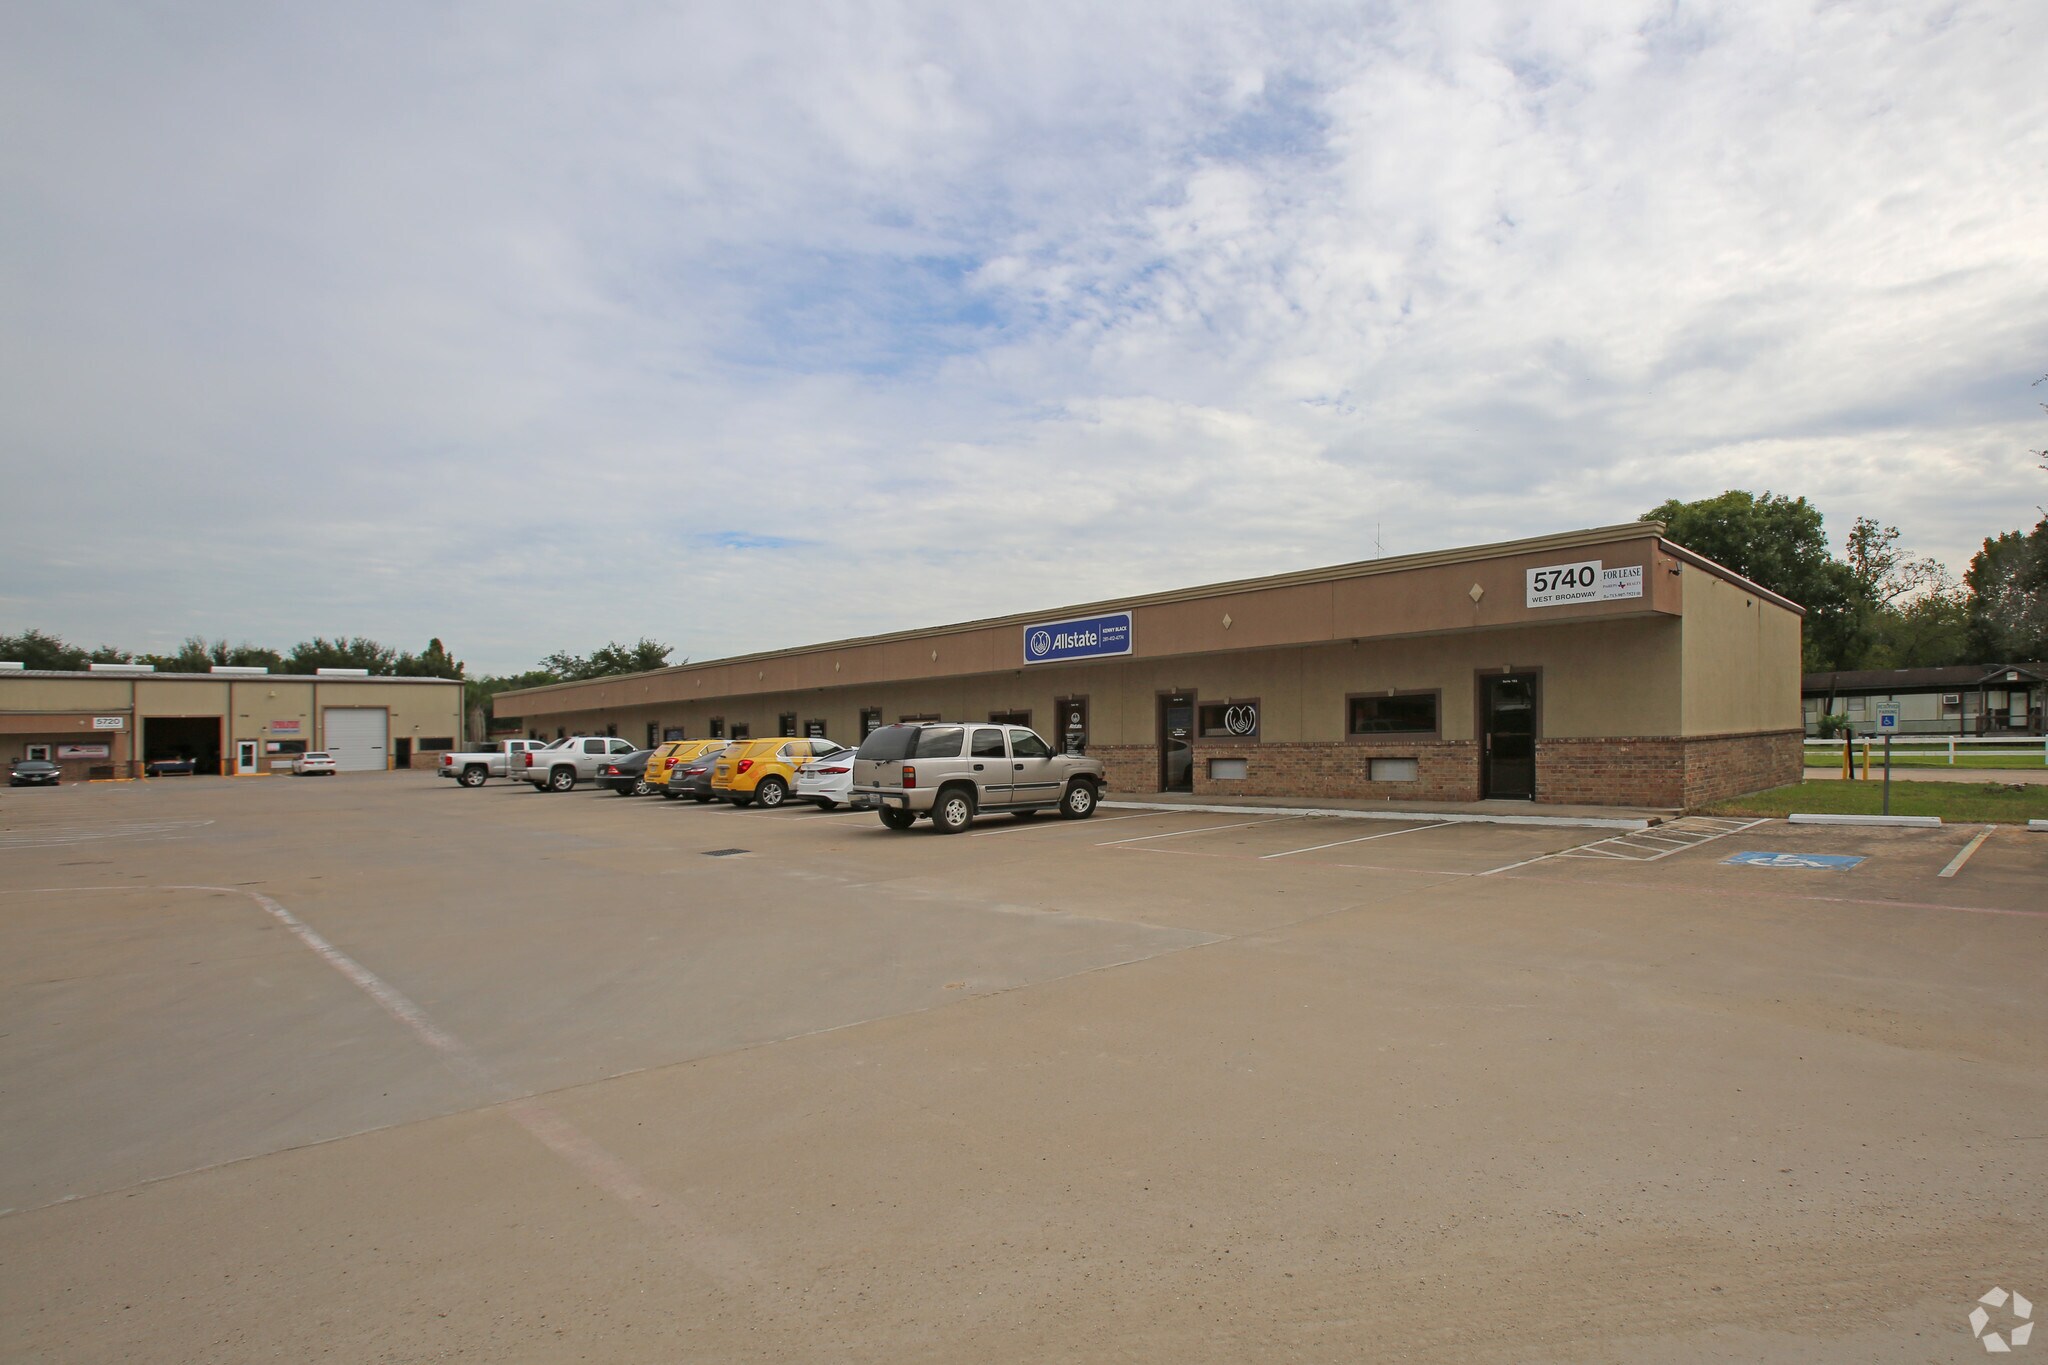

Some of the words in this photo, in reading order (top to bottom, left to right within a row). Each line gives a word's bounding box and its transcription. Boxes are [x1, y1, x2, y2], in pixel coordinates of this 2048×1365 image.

[1533, 566, 1595, 592] 5740
[1603, 570, 1618, 580] FOR
[1619, 567, 1641, 578] LEASE
[1532, 595, 1553, 603] WEST
[1555, 591, 1596, 601] BROADWAY
[1052, 630, 1097, 650] Allstate
